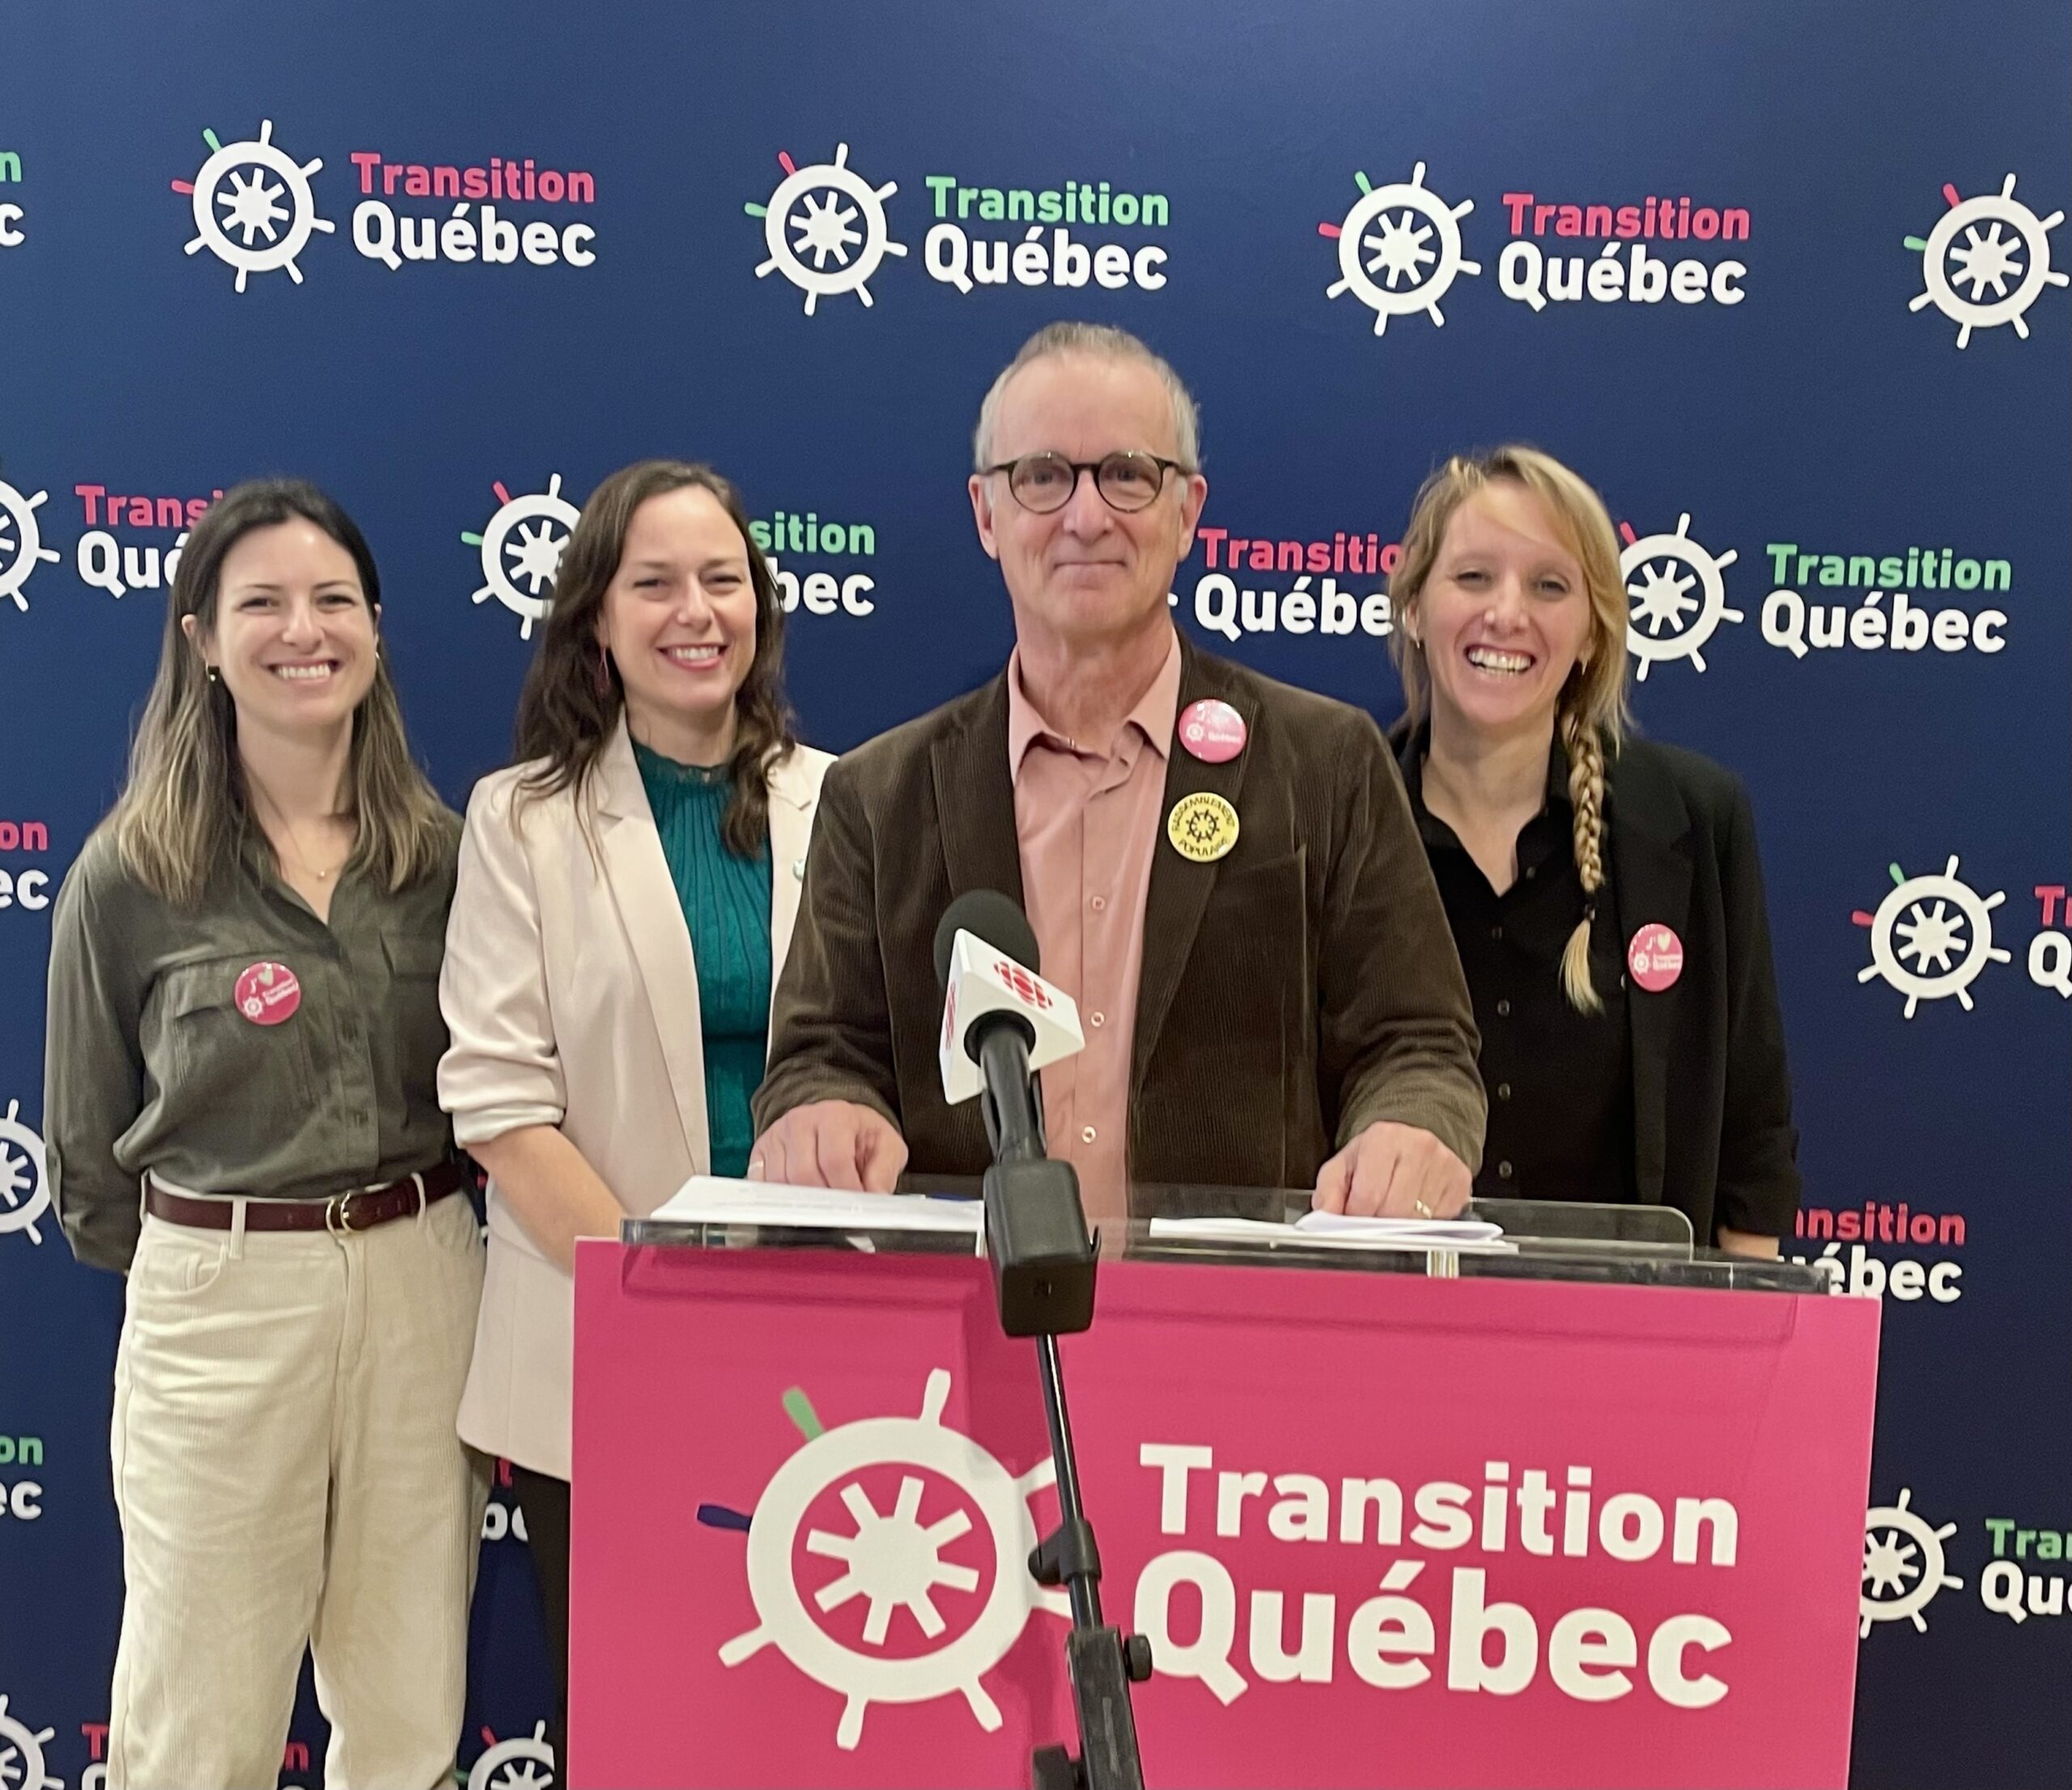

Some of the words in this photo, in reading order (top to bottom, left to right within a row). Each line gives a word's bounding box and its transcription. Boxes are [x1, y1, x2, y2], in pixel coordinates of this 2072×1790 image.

[351, 152, 595, 203] Transition
[925, 176, 1169, 226] Transition
[351, 200, 597, 271] Québec
[1502, 193, 1750, 240] Transition
[924, 223, 1168, 295] Québec
[1498, 240, 1747, 312] Québec
[75, 485, 223, 528] Trans
[748, 511, 875, 555] sition
[1197, 528, 1403, 574] Transitio
[1766, 544, 2012, 591] Transition
[764, 557, 875, 617] bec
[1195, 573, 1395, 643] Québe
[1761, 589, 2008, 660] Québec
[1795, 1201, 1966, 1245] nsition
[1777, 1241, 1963, 1303] ébec
[1140, 1443, 1739, 1567] Transition
[1134, 1550, 1733, 1708] Québec
